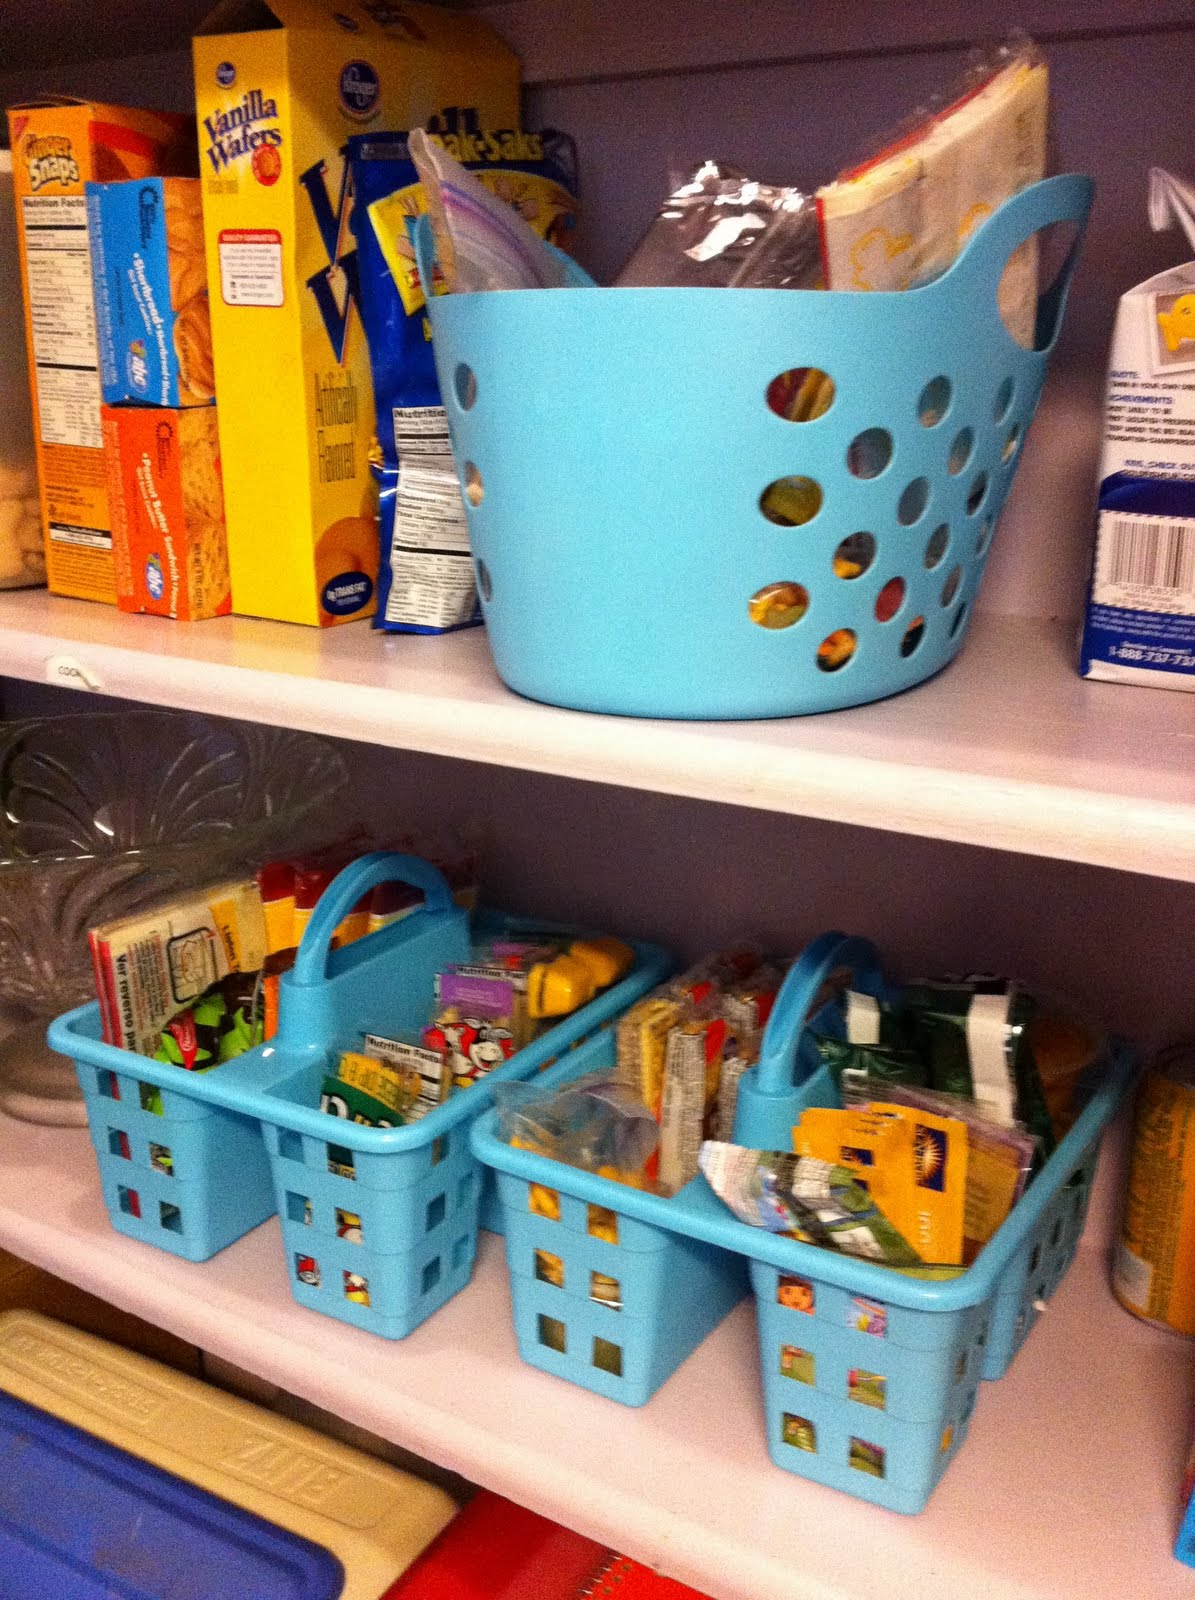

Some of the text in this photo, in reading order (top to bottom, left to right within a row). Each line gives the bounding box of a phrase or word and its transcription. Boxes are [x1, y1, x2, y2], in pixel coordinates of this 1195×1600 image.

[203, 89, 278, 144] Vanilla
[206, 123, 282, 174] Wafers
[29, 156, 80, 192] Snaps
[143, 458, 157, 498] Peanut
[153, 500, 169, 533] Butter
[116, 955, 127, 976] Ver
[119, 980, 133, 1028] reverso
[367, 1035, 441, 1064] Nutrition Facts
